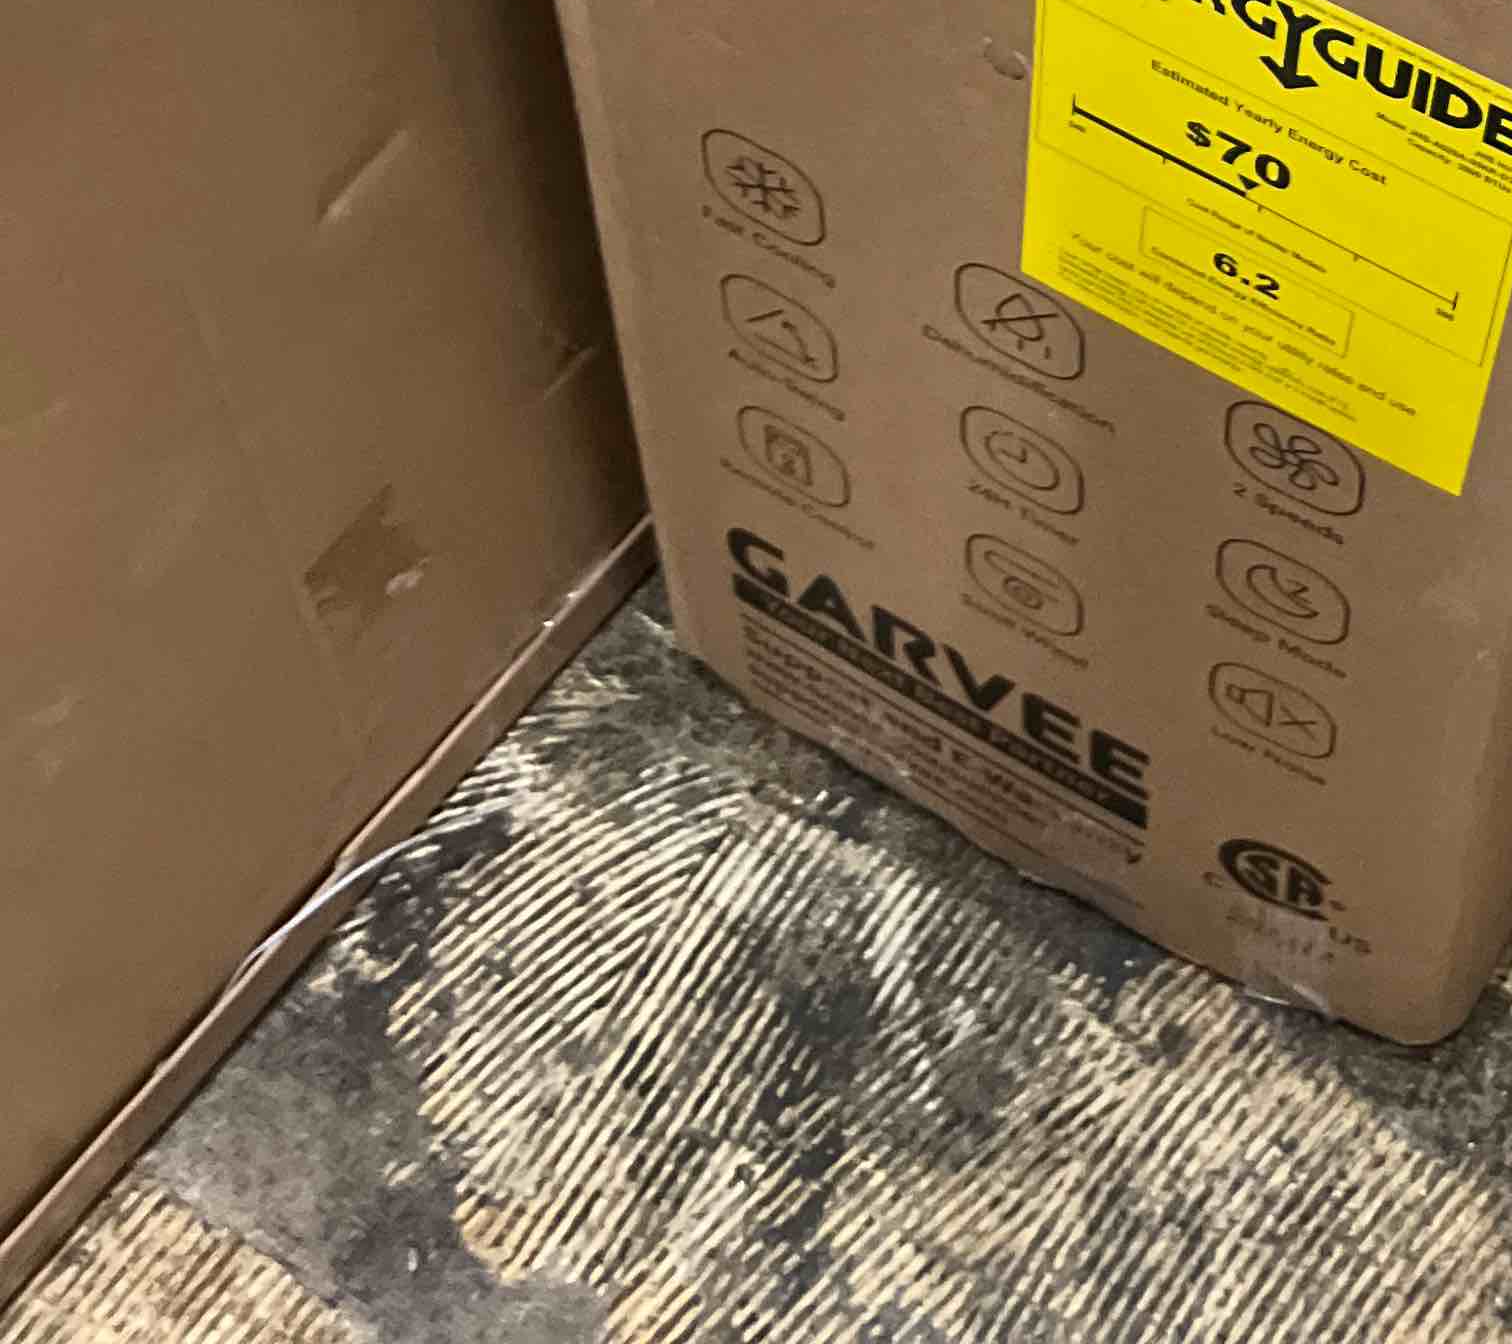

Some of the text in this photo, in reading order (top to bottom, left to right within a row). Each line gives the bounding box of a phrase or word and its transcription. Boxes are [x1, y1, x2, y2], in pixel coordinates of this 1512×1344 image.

[1151, 59, 1387, 187] Estimated Yearly Energy Cost
[1183, 114, 1293, 195] $70
[1211, 247, 1282, 303] 6.2
[727, 526, 1152, 804] GARVEE
